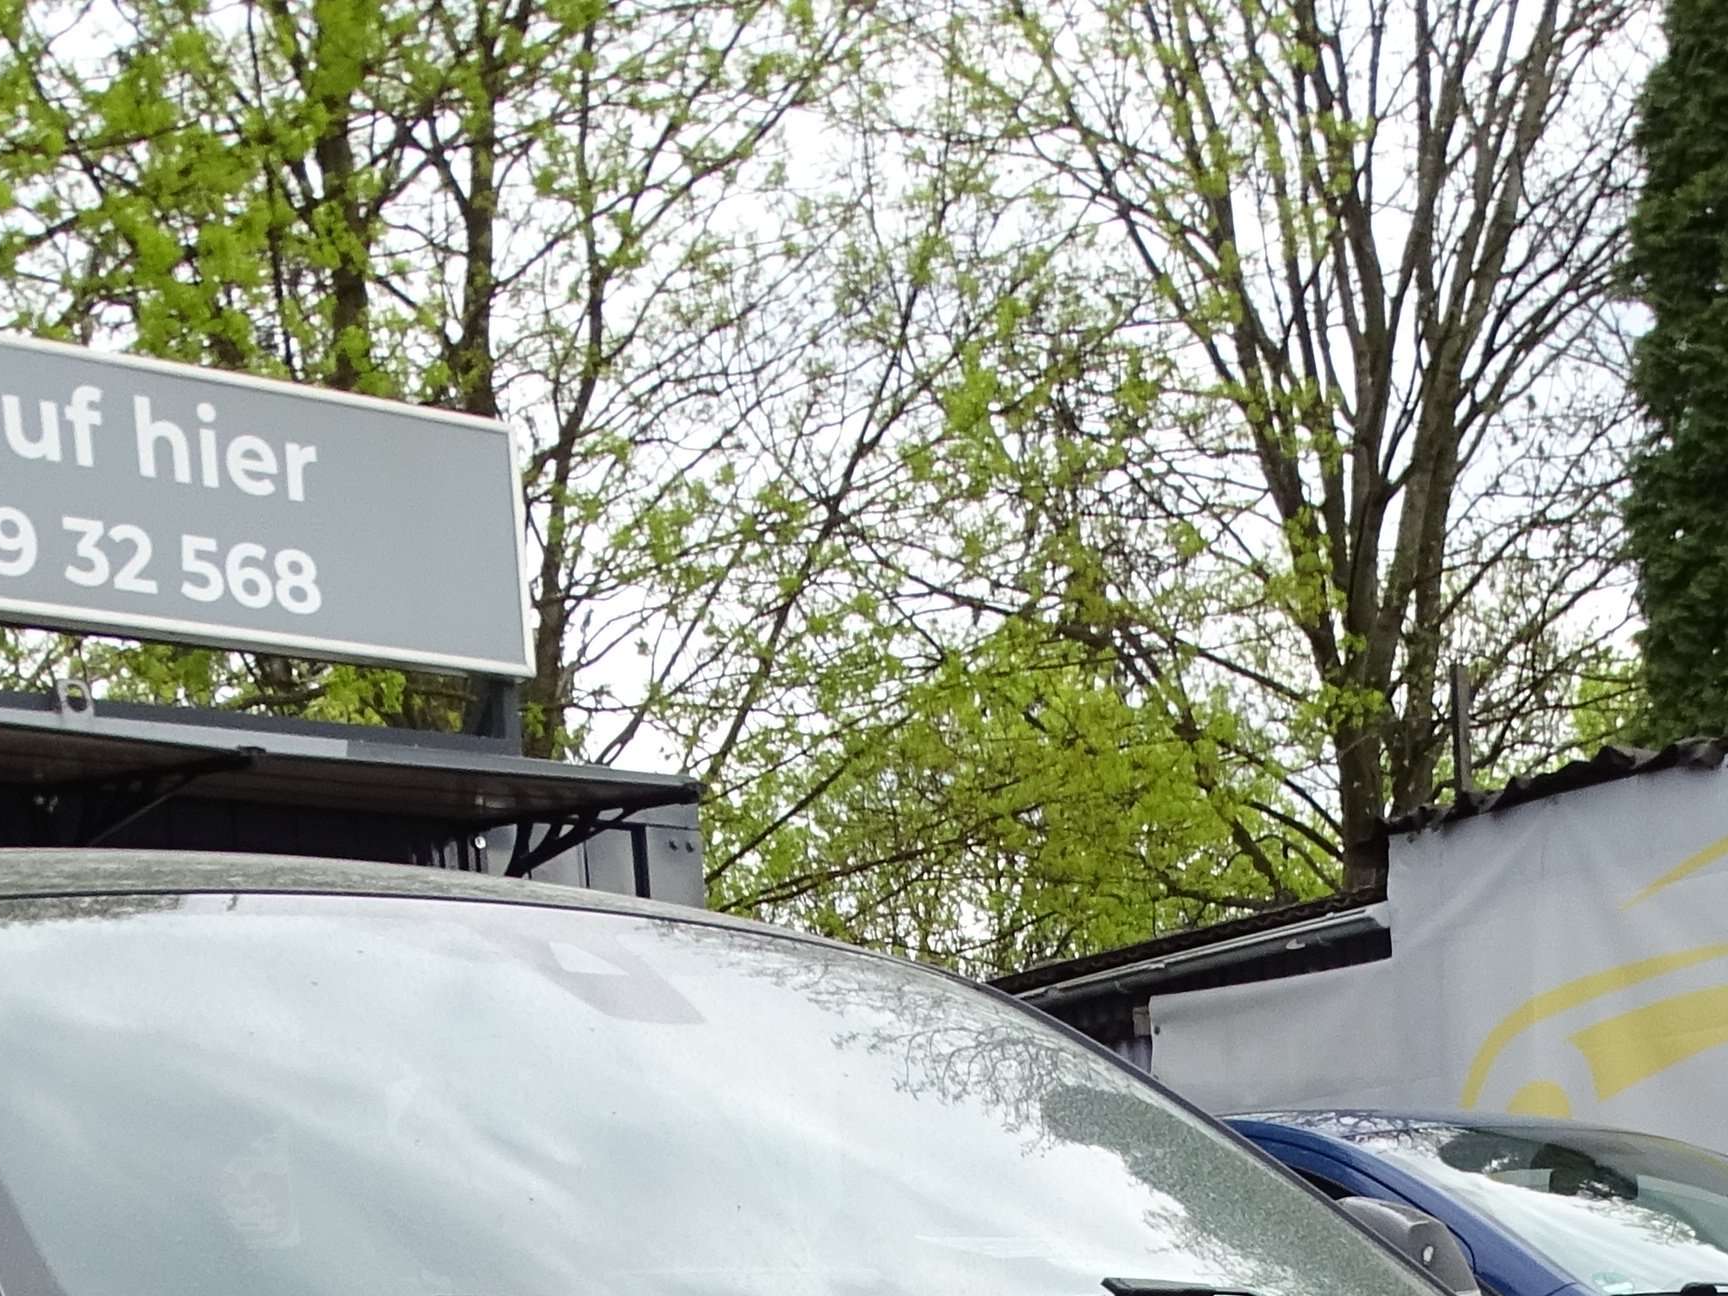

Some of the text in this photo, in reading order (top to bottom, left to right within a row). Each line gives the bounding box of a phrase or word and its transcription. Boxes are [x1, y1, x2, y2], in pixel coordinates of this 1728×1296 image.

[134, 396, 318, 501] hier
[61, 516, 158, 594] 32
[180, 534, 322, 615] 568
